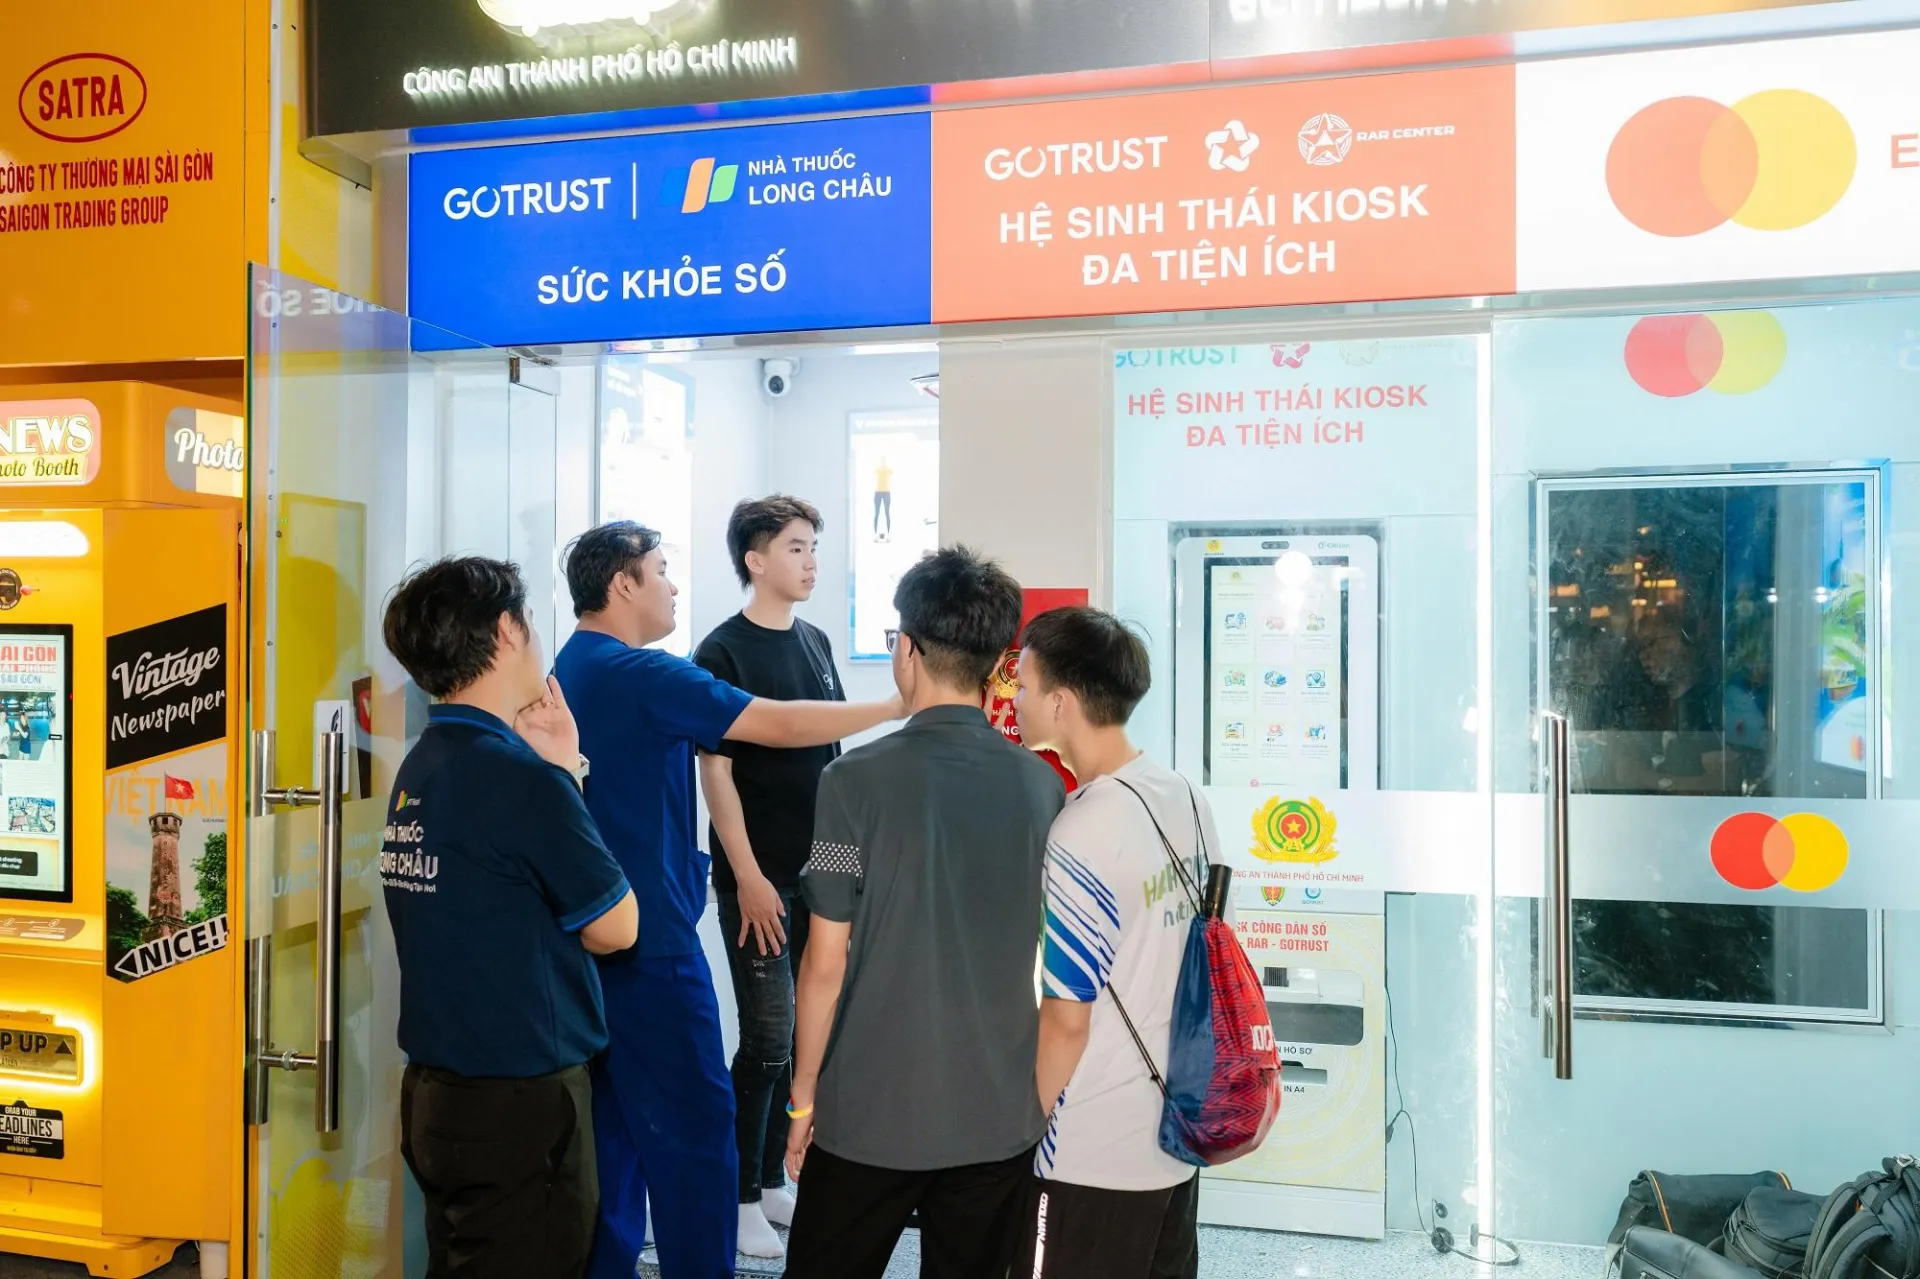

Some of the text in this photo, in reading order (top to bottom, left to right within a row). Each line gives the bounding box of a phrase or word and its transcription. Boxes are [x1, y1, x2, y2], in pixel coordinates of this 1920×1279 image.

[403, 37, 797, 94] CÔNG AN THÀNH PHỐ HỒ CHÍ MINH
[38, 74, 125, 122] SATRA
[1356, 125, 1455, 141] RAR CENTER
[748, 147, 856, 176] NHÀ THUỐC
[984, 136, 1168, 181] GOTRUST
[1891, 133, 1920, 169] E
[0, 148, 213, 194] CÔNG TY THƯƠNG MẠI SÀI GÒN
[443, 176, 612, 220] GOTRUST
[748, 172, 892, 206] LONG CHÂU
[0, 195, 169, 233] SAIGON TRADING GROUP
[999, 183, 1430, 248] HỆ SINH THÁI KIOSK
[537, 248, 787, 305] SỨC KHỎE SỐ
[1082, 234, 1337, 287] ĐA TIỆN ÍCH
[1128, 383, 1428, 420] HỆ SINH THÁI KIOSK
[174, 427, 244, 472] Photo
[1186, 416, 1364, 449] ĐA TIỆN ÍCH
[0, 457, 79, 477] oto Booth
[0, 646, 18, 661] AI
[111, 647, 220, 700] Vintage
[111, 690, 226, 741] Newspaper
[380, 852, 397, 874] ONG
[397, 848, 438, 880] CHÂU
[1249, 870, 1260, 878] AN
[1262, 870, 1291, 880] THÀNH
[1293, 870, 1311, 881] PHỐ
[1312, 871, 1325, 881] HỒ
[1342, 874, 1364, 882] MINH
[1247, 937, 1268, 949] RAR
[1280, 938, 1329, 952] GOTRUST
[1252, 920, 1282, 934] CÔNG
[1286, 921, 1308, 936] DÂN
[1312, 921, 1327, 936] SỐ
[20, 1034, 48, 1053] UP
[1284, 1045, 1297, 1055] HỒ
[1299, 1046, 1313, 1055] SƠ
[0, 1116, 53, 1137] EADLINES
[5, 1106, 37, 1116] GRAB YOUR
[13, 1136, 30, 1145] HERE
